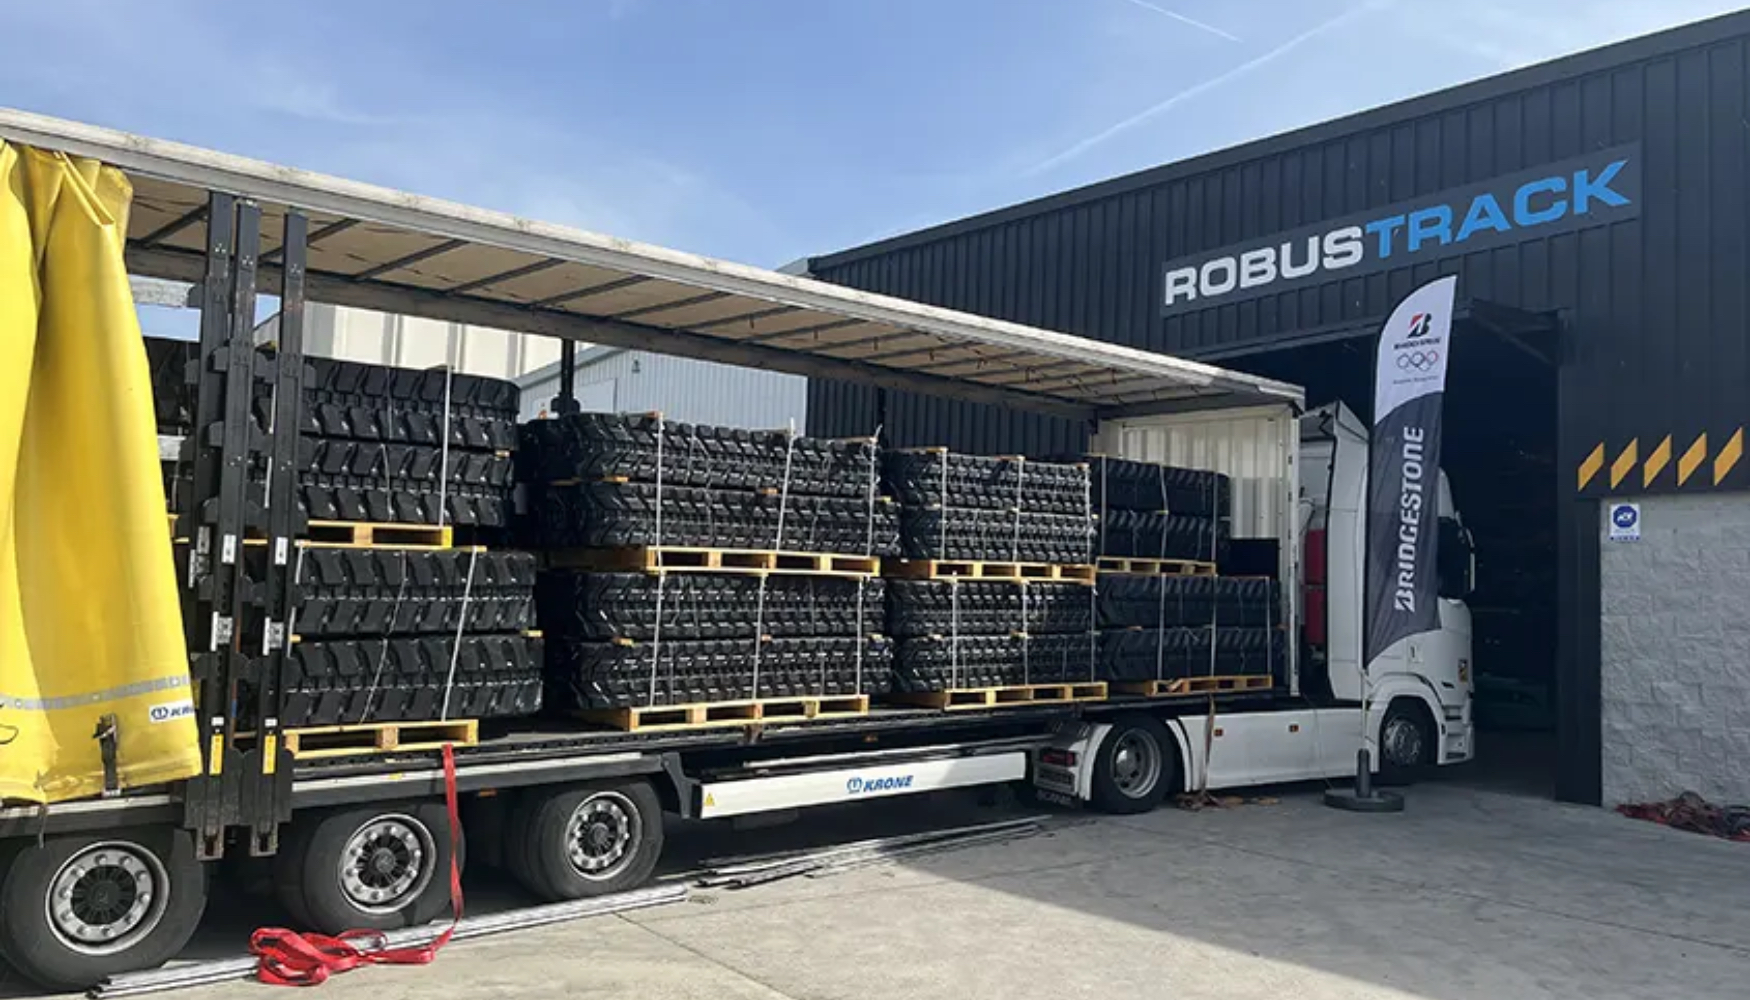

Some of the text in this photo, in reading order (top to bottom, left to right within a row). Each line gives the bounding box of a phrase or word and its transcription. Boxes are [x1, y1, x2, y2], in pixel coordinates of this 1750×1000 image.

[1164, 159, 1632, 306] ROBUSTRACK
[1394, 426, 1425, 613] BRIDGESTONE
[863, 775, 914, 793] KRONE
